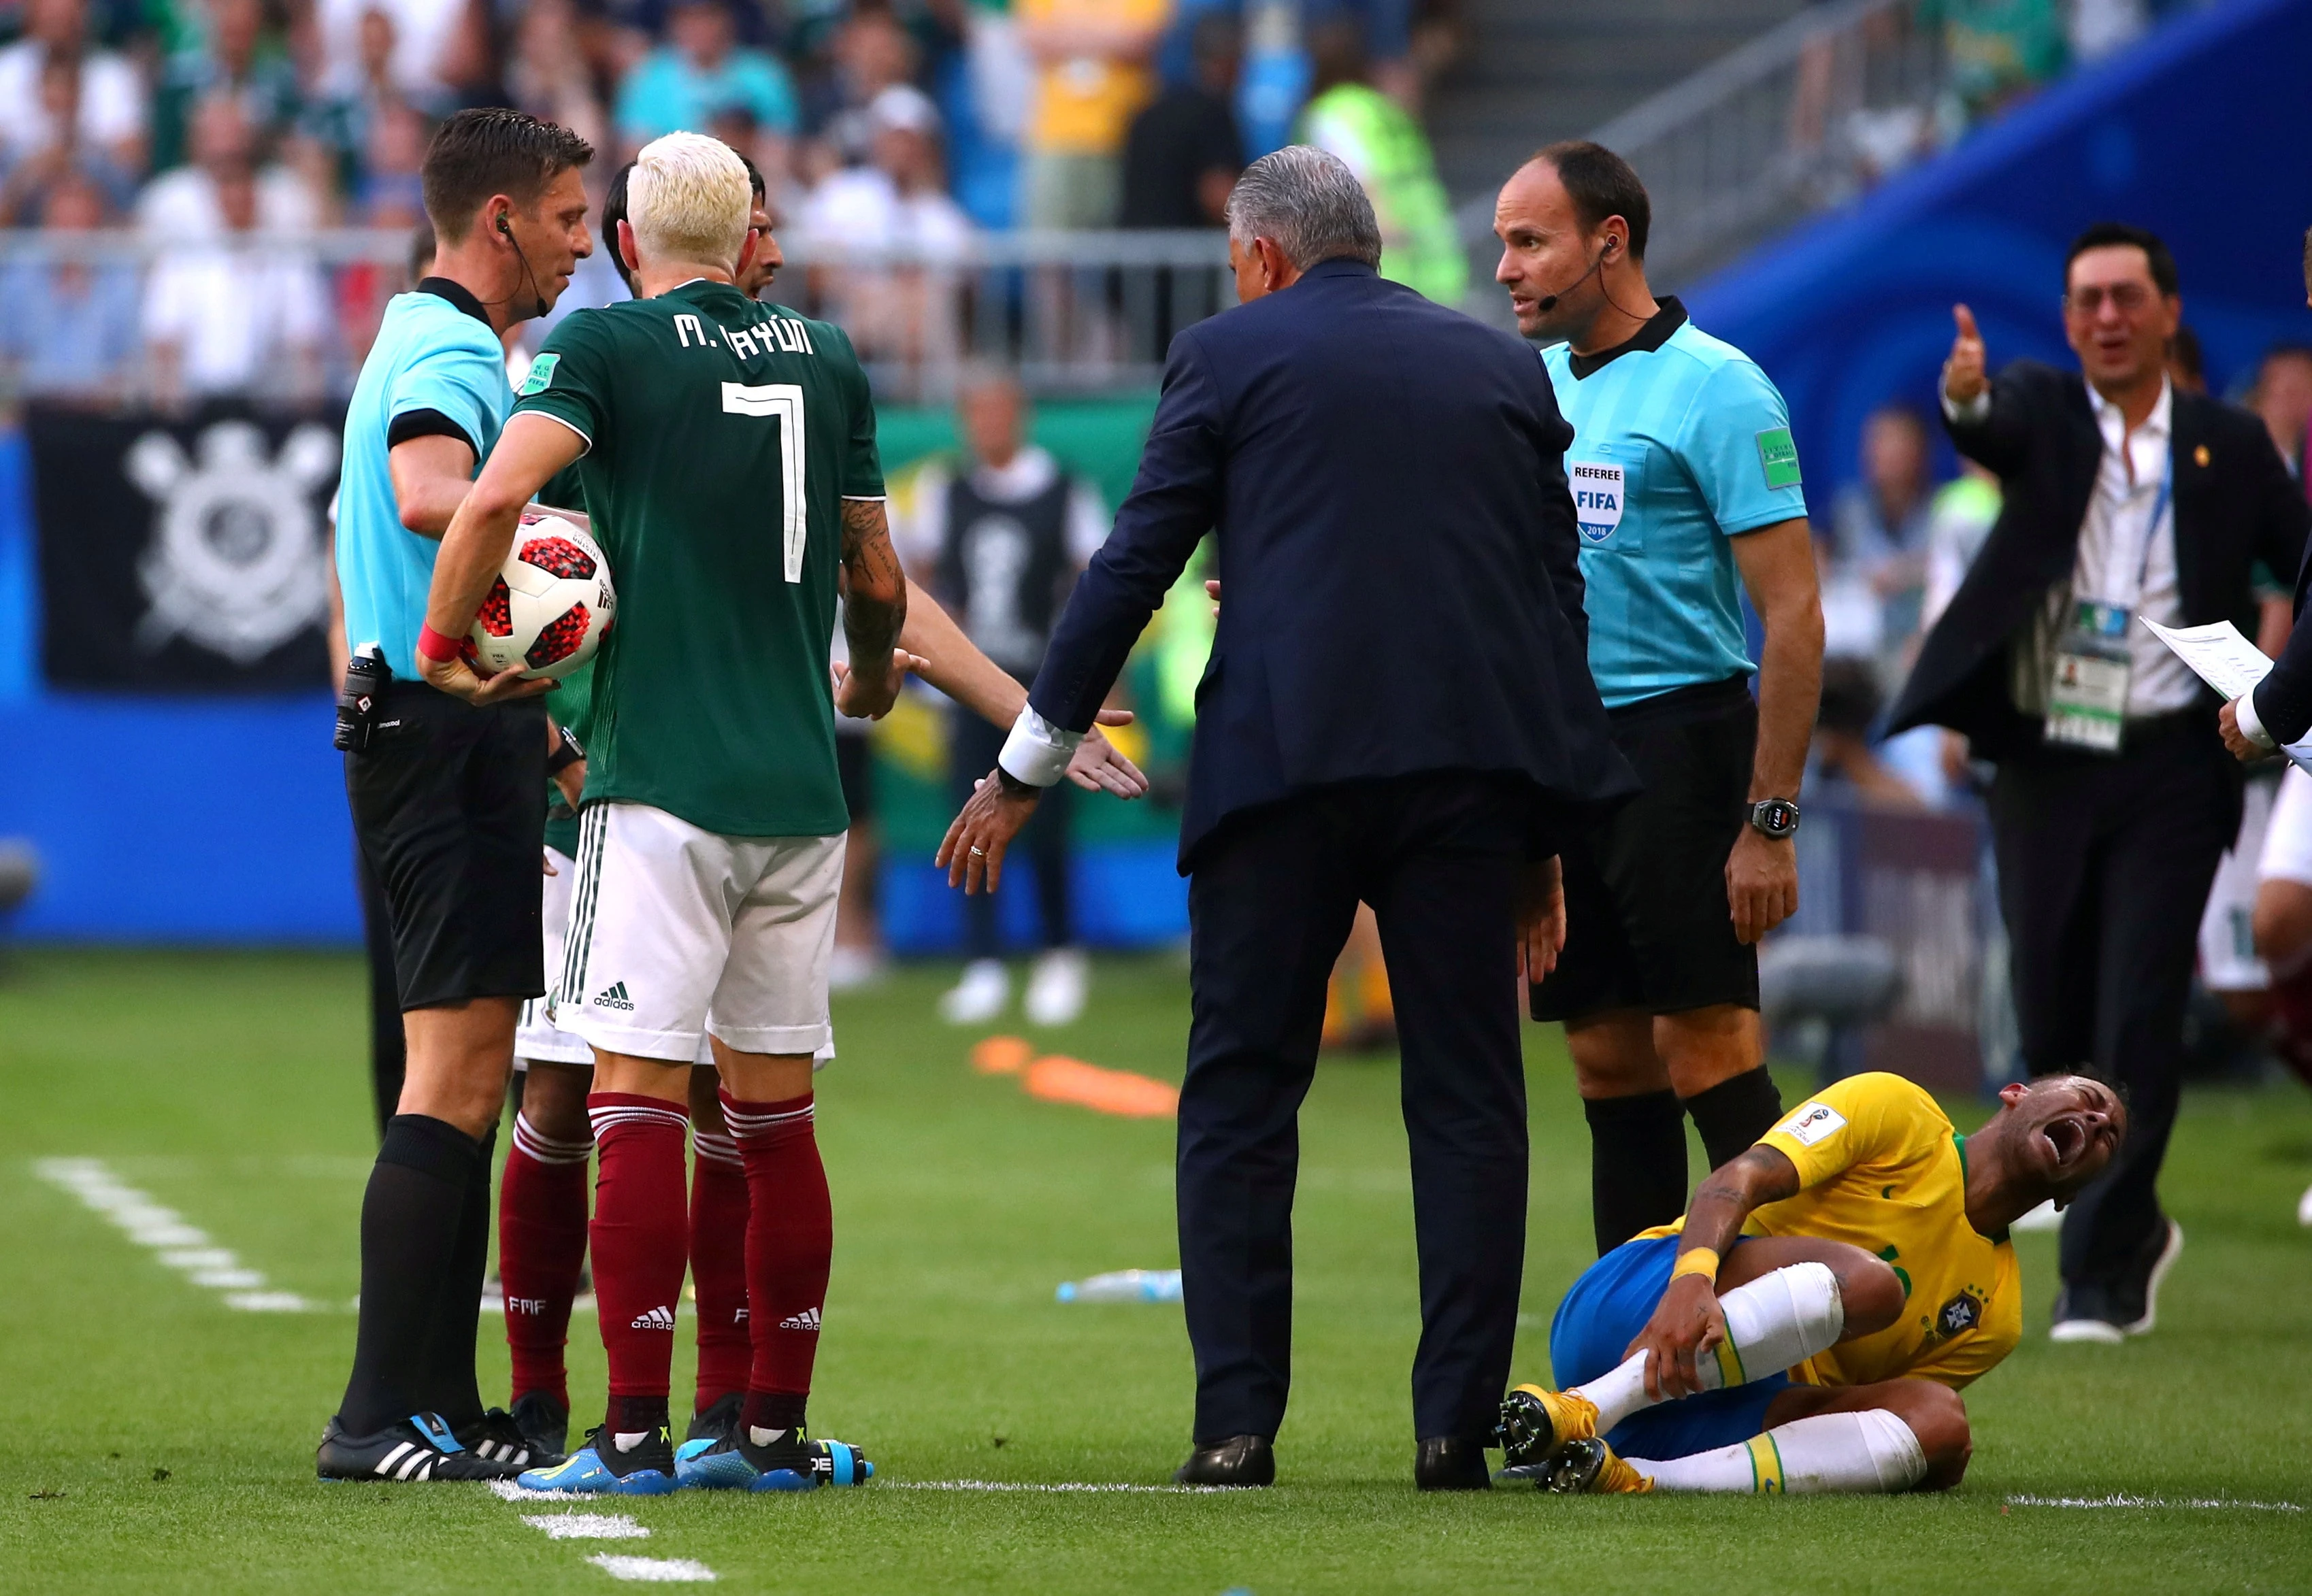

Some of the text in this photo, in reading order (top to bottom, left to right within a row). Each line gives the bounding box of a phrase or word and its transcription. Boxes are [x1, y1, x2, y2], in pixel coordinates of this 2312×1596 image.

[673, 314, 718, 348] M.
[528, 378, 544, 387] FIFA
[1574, 467, 1621, 481] REFEREE
[721, 381, 807, 584] 7
[1577, 491, 1617, 511] FIFA
[1587, 526, 1606, 535] 2018
[593, 997, 634, 1012] adidas
[508, 1295, 546, 1316] FMF
[734, 1308, 749, 1323] F
[779, 1320, 821, 1331] adida
